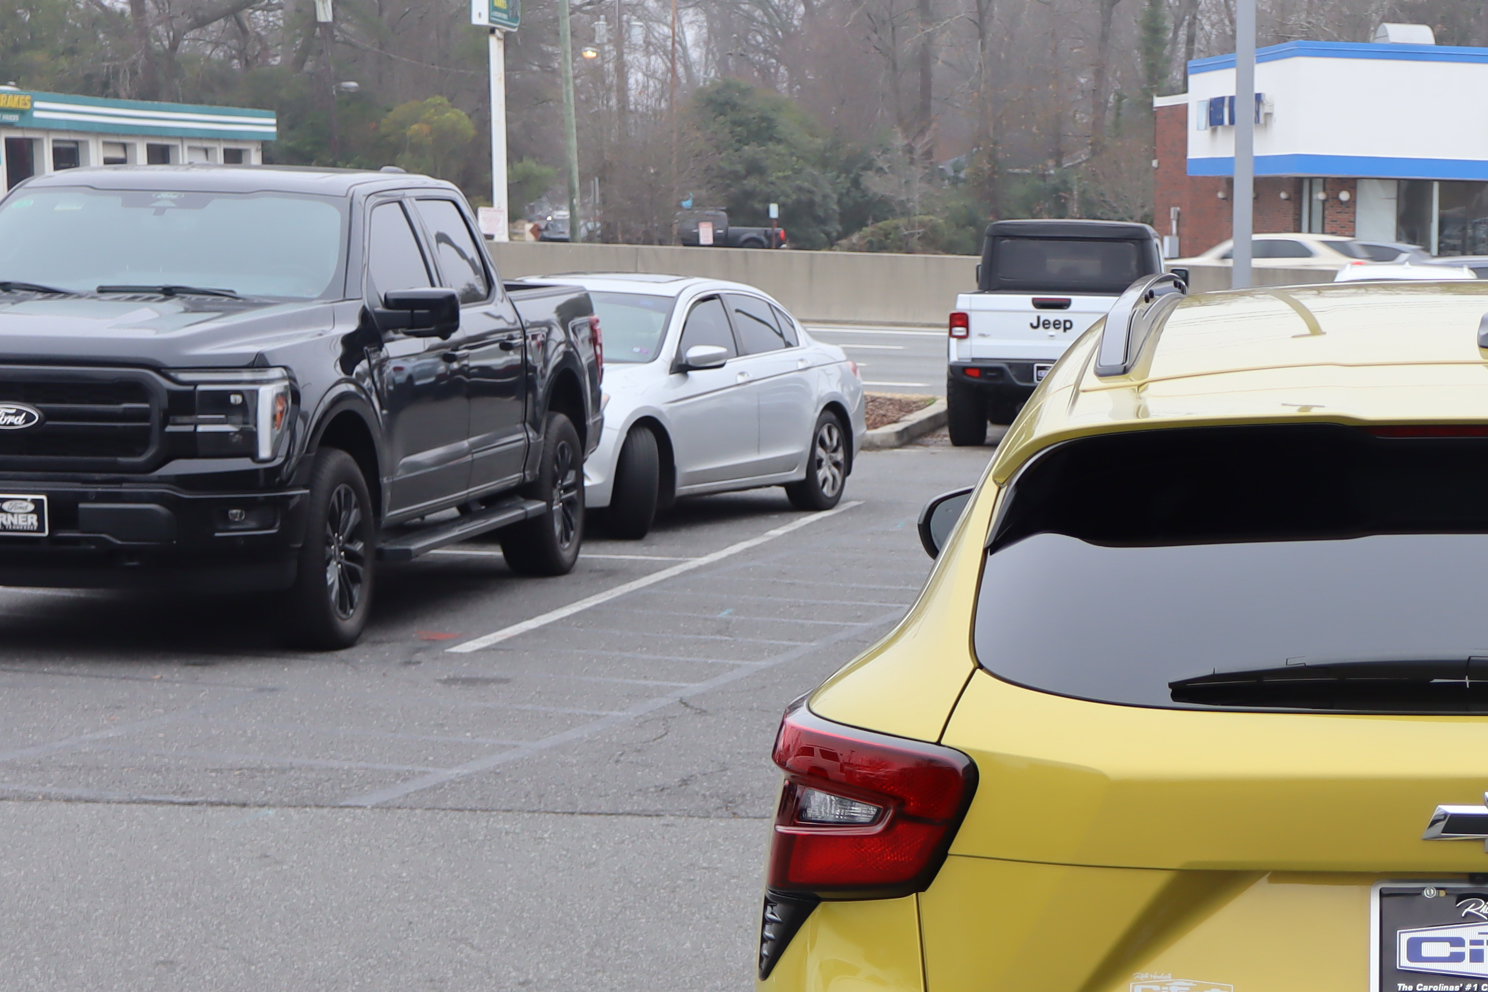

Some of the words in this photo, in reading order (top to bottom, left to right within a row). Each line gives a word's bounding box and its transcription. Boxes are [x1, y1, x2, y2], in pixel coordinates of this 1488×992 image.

[1030, 315, 1073, 333] Jeep
[1397, 983, 1413, 992] The
[1416, 983, 1463, 992] Carolinas'
[1465, 983, 1478, 992] #1
